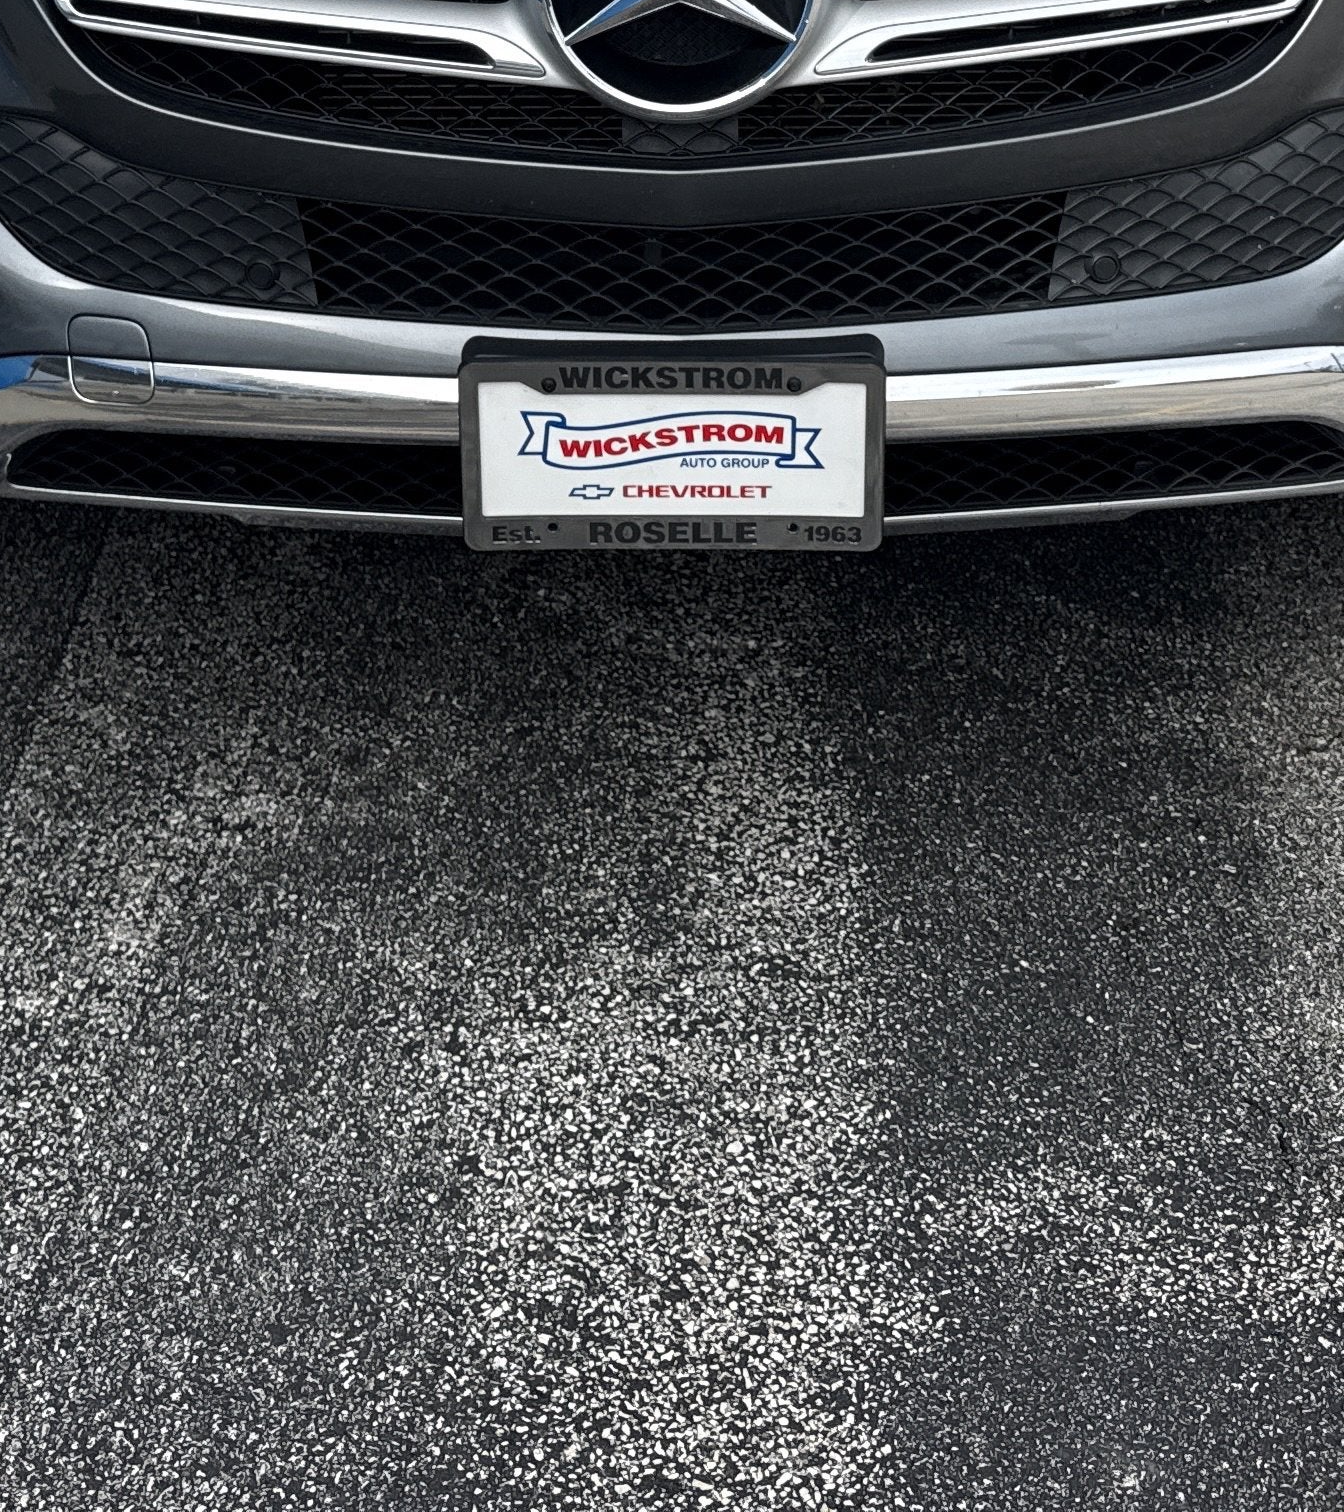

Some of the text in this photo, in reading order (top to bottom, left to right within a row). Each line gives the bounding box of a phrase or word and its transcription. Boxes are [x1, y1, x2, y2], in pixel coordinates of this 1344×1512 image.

[559, 366, 783, 391] WICKSTROM
[559, 423, 784, 459] WICKSTROM
[680, 457, 770, 470] AUTO GROUP
[622, 484, 773, 500] CHEVROLET
[492, 521, 863, 546] Est. ROSELLE 1963
